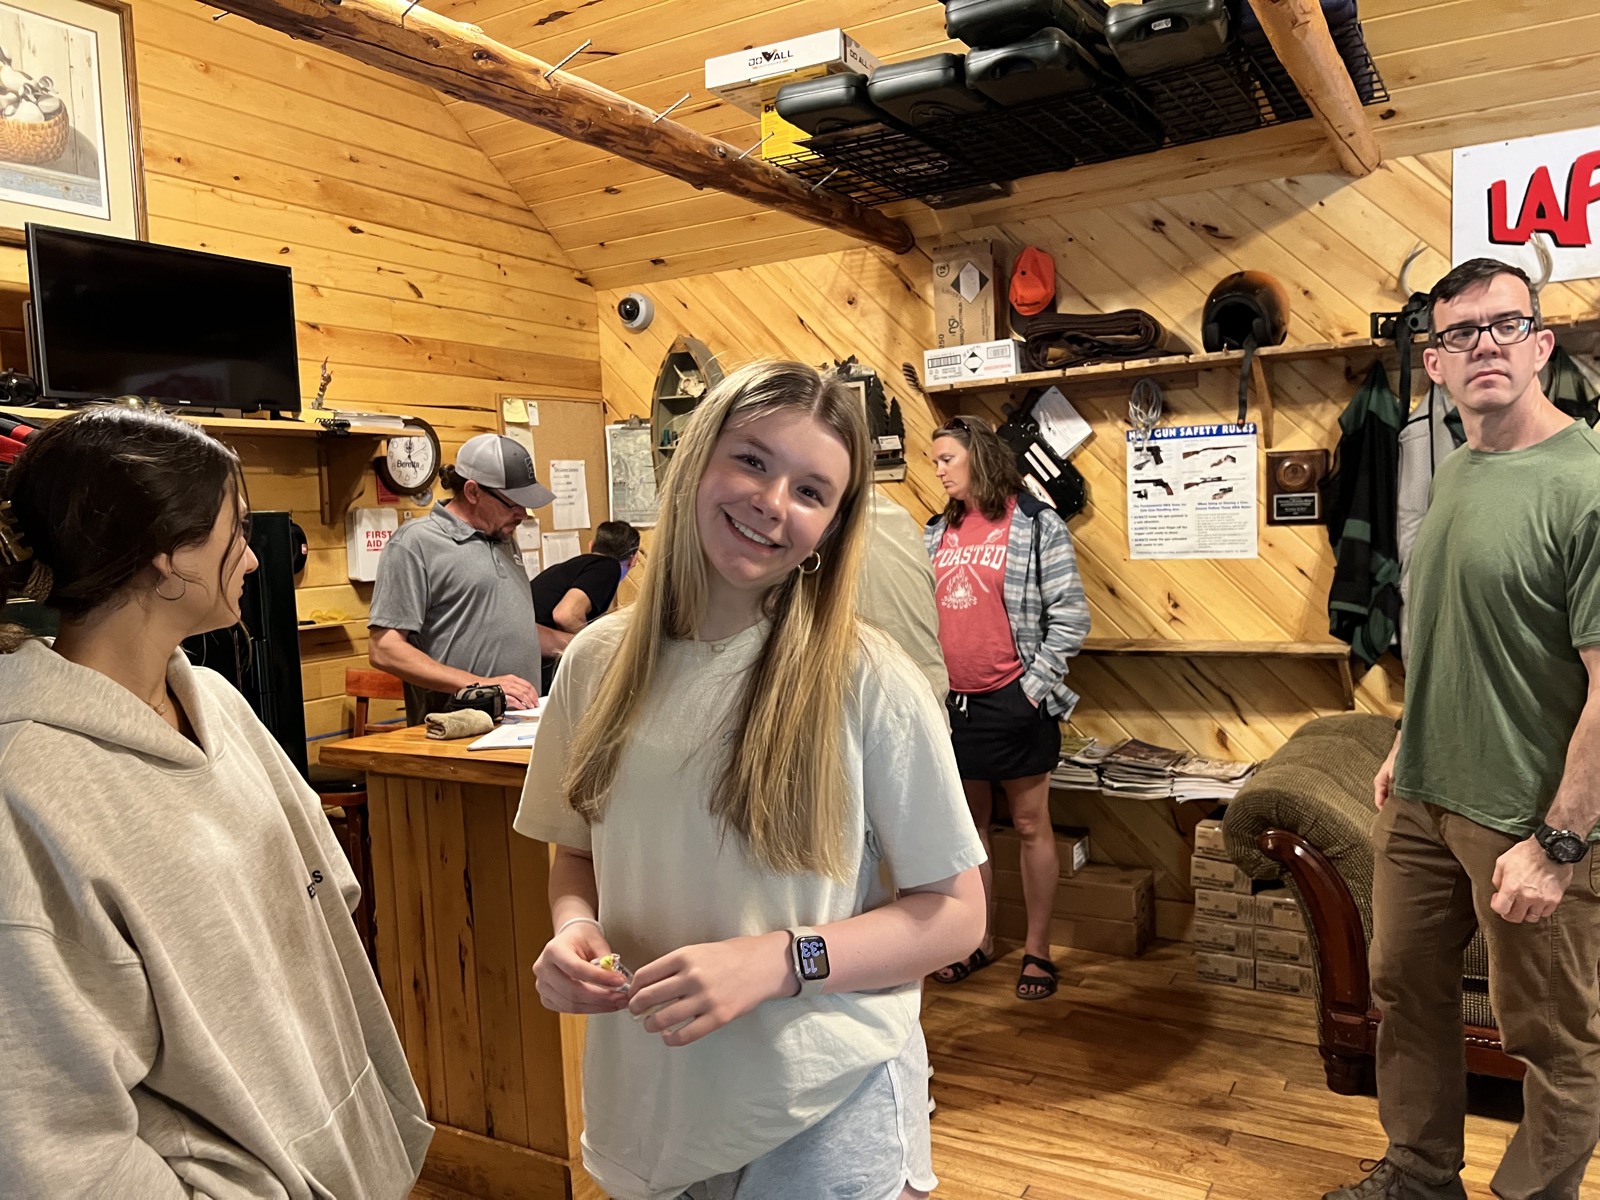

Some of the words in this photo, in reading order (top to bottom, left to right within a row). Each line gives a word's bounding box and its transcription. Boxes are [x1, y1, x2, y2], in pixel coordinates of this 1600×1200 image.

[1154, 428, 1176, 438] GUN
[1180, 425, 1218, 436] SAFETY
[397, 459, 420, 468] Beretta
[366, 530, 393, 539] FIRST
